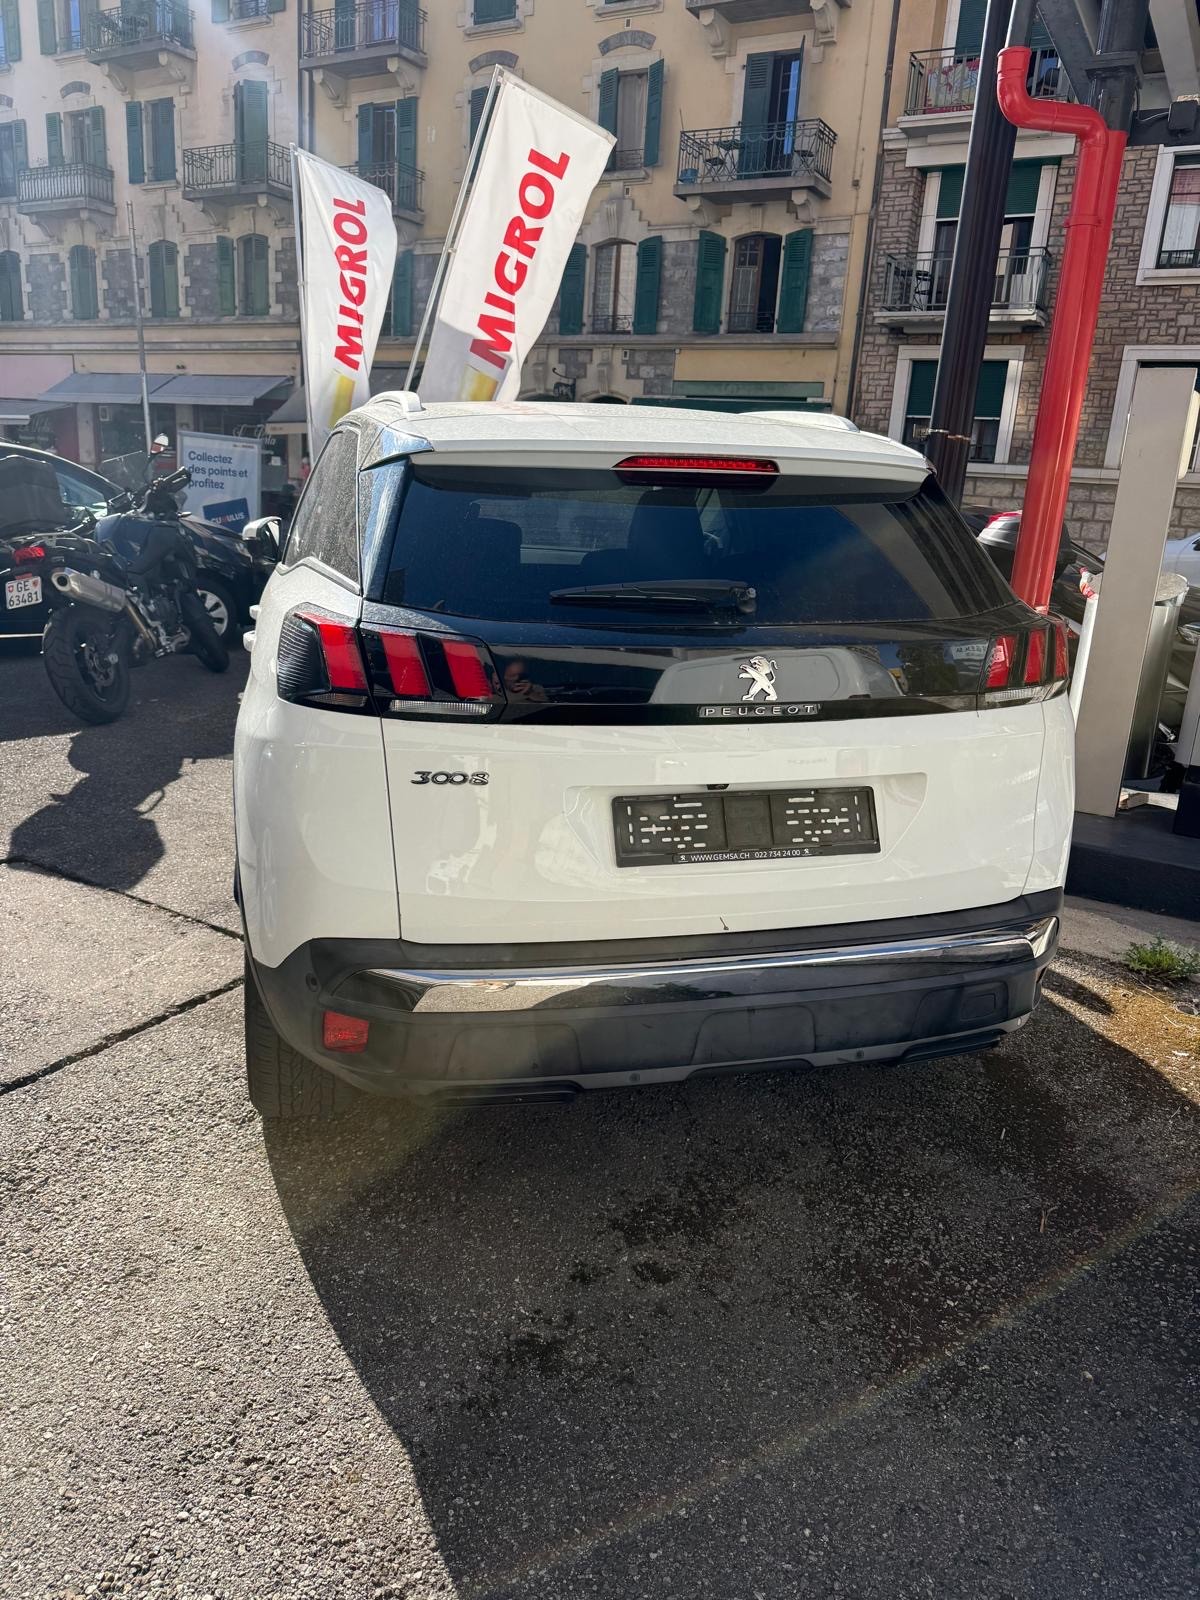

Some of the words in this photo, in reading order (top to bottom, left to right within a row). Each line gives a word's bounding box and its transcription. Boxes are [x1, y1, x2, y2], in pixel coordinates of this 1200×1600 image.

[469, 148, 570, 370] MIGROL
[333, 197, 368, 371] MIGROL
[188, 450, 233, 464] Collectez
[188, 464, 207, 475] des
[208, 467, 238, 478] points
[238, 470, 249, 478] et
[188, 478, 225, 490] profitez
[17, 580, 30, 592] GE
[9, 591, 39, 607] 63481
[705, 704, 814, 716] PEUGEOT
[410, 770, 490, 785] 3008
[690, 852, 750, 862] WWW.GEMSA.CH
[754, 851, 768, 859] 022
[769, 850, 781, 858] 734
[782, 849, 791, 857] 24
[792, 849, 801, 857] 00
